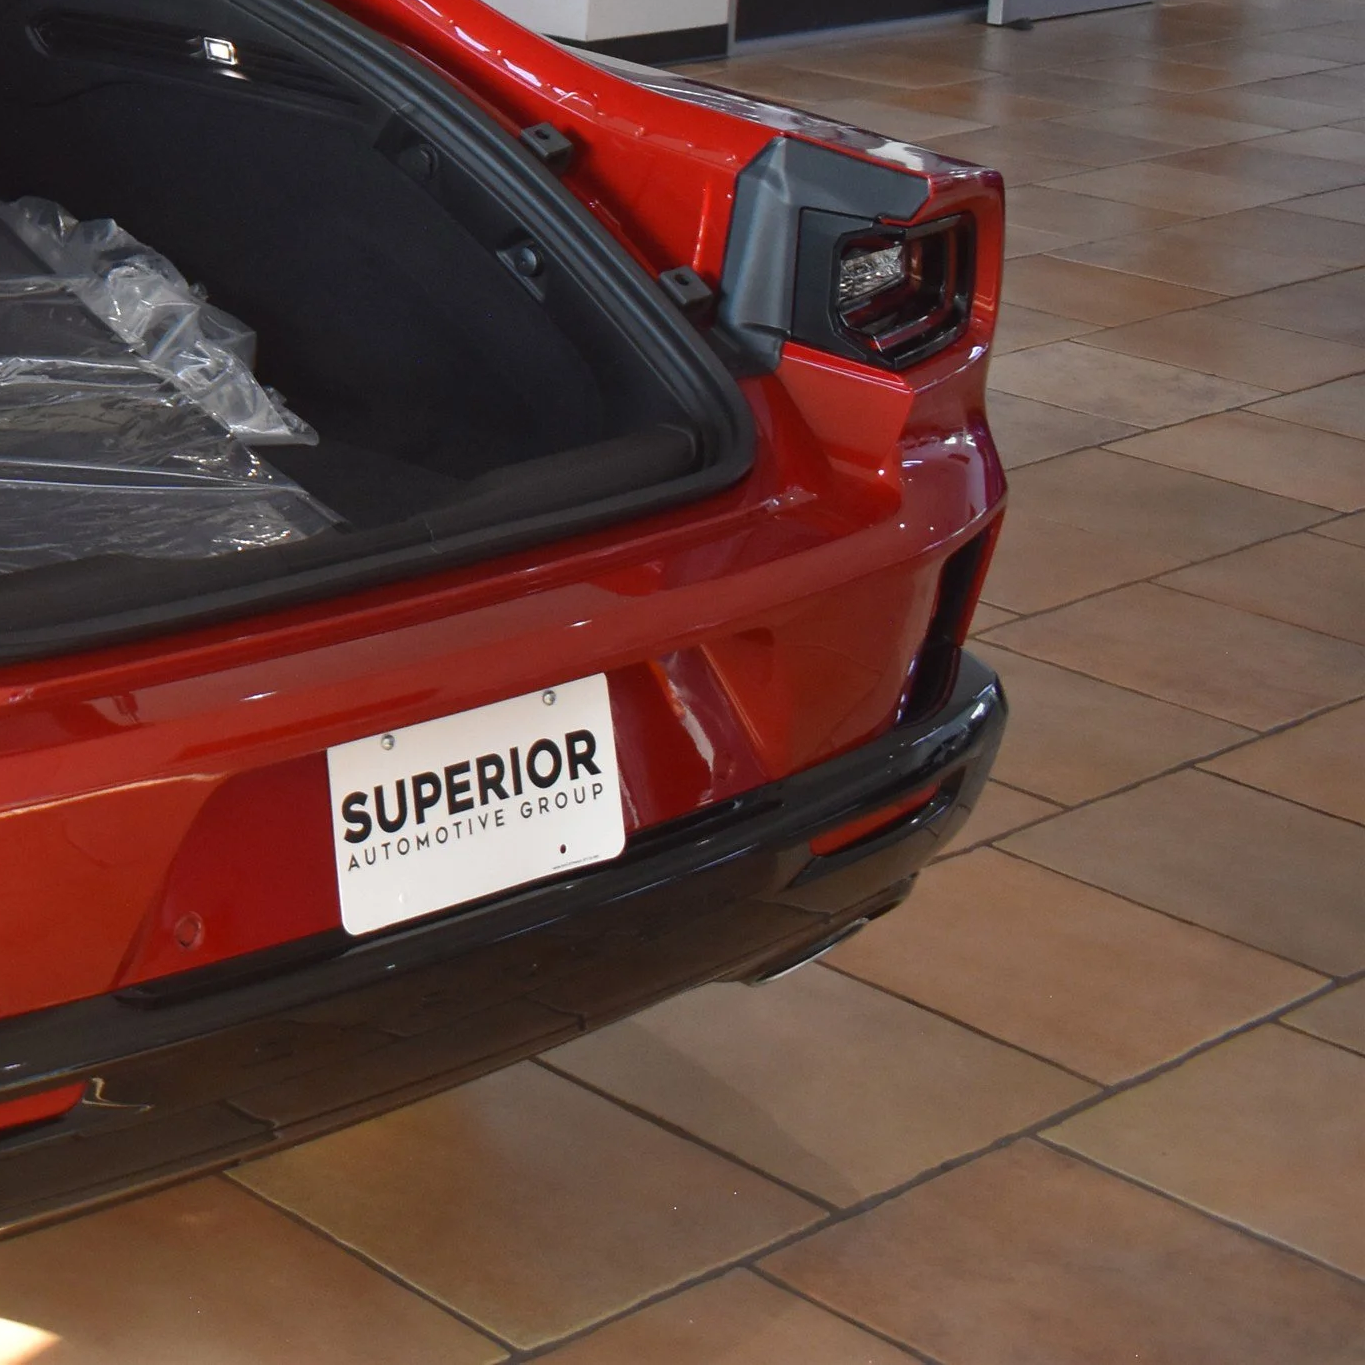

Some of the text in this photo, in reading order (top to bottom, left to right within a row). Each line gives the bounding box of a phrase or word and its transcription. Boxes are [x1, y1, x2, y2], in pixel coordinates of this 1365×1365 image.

[341, 729, 602, 844] SUPERIOR
[348, 782, 604, 871] AUTOMOTIVE GROUP
